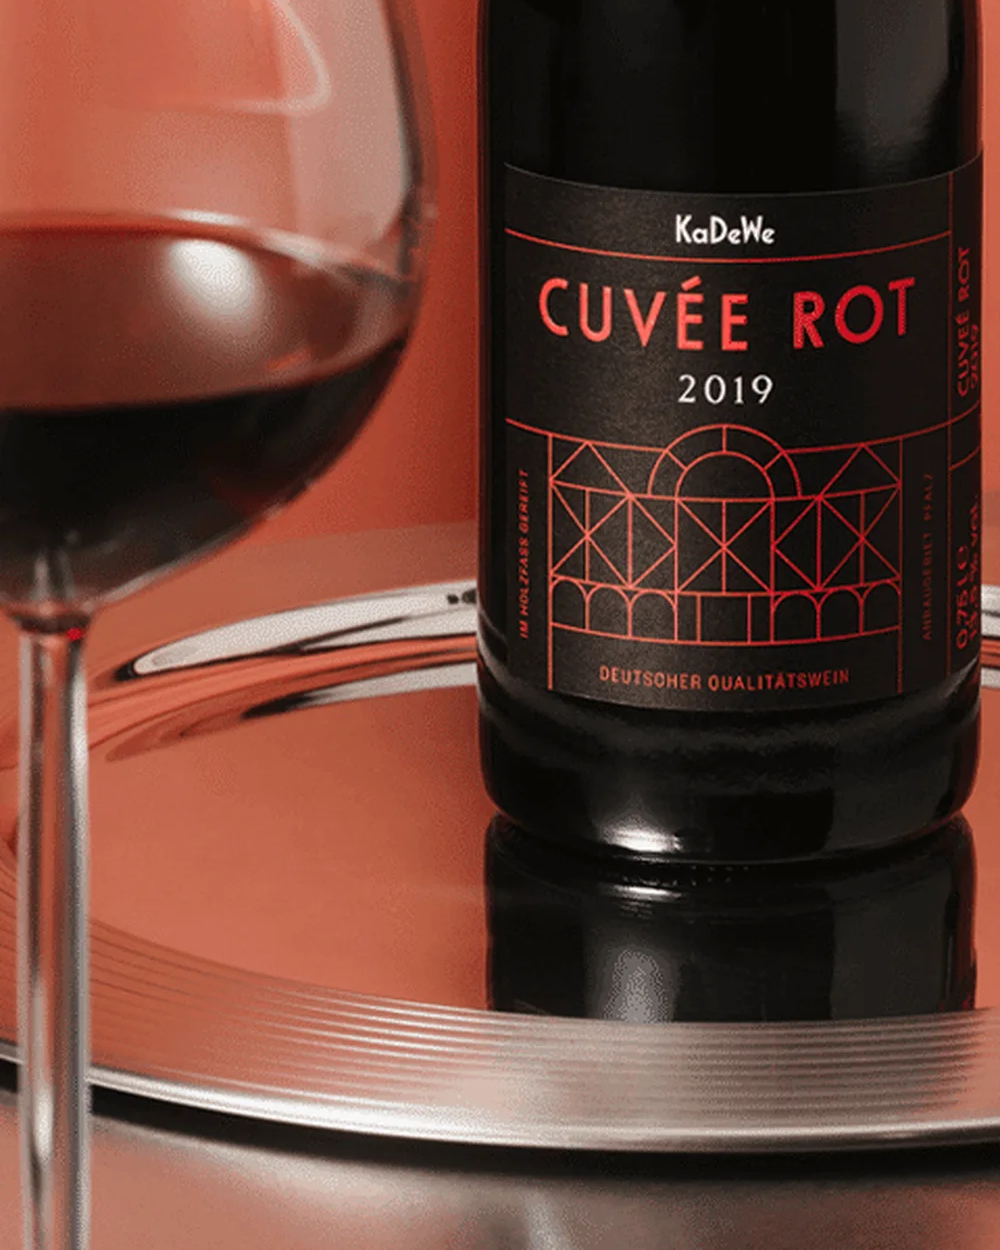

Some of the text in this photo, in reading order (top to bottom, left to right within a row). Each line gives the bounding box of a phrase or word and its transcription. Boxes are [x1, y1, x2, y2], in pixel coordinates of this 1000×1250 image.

[676, 214, 775, 245] KaDeWe
[538, 276, 915, 351] CUVÉE ROT
[954, 247, 971, 398] CUVÉE ROT
[677, 374, 774, 405] 2019
[519, 469, 529, 639] IM HOLZFASS GEREIFT
[599, 665, 850, 692] DEUTSCHER QUALITÄTSWEIN
